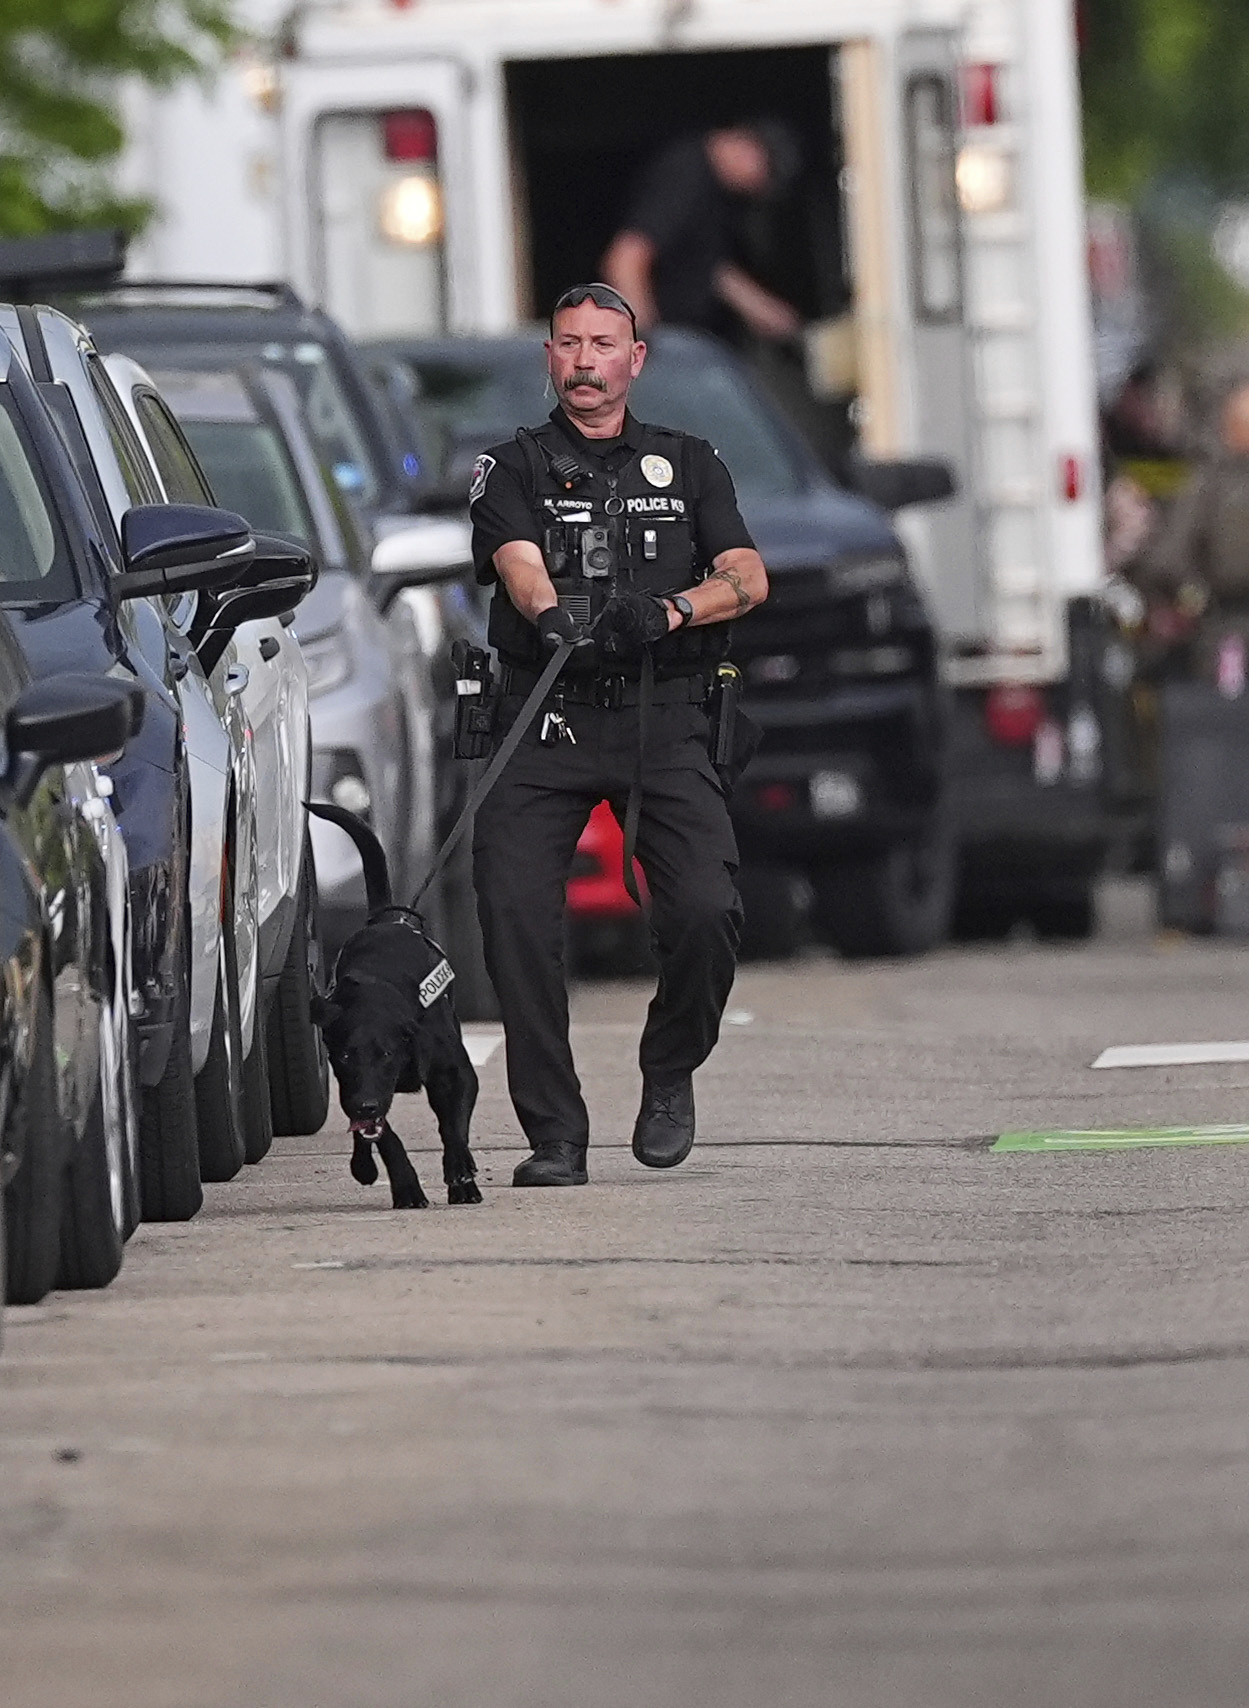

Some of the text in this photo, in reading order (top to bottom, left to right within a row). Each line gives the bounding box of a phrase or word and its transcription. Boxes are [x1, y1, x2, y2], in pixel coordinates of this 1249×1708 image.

[556, 500, 592, 510] ARROYO
[627, 498, 685, 513] POLICE K9
